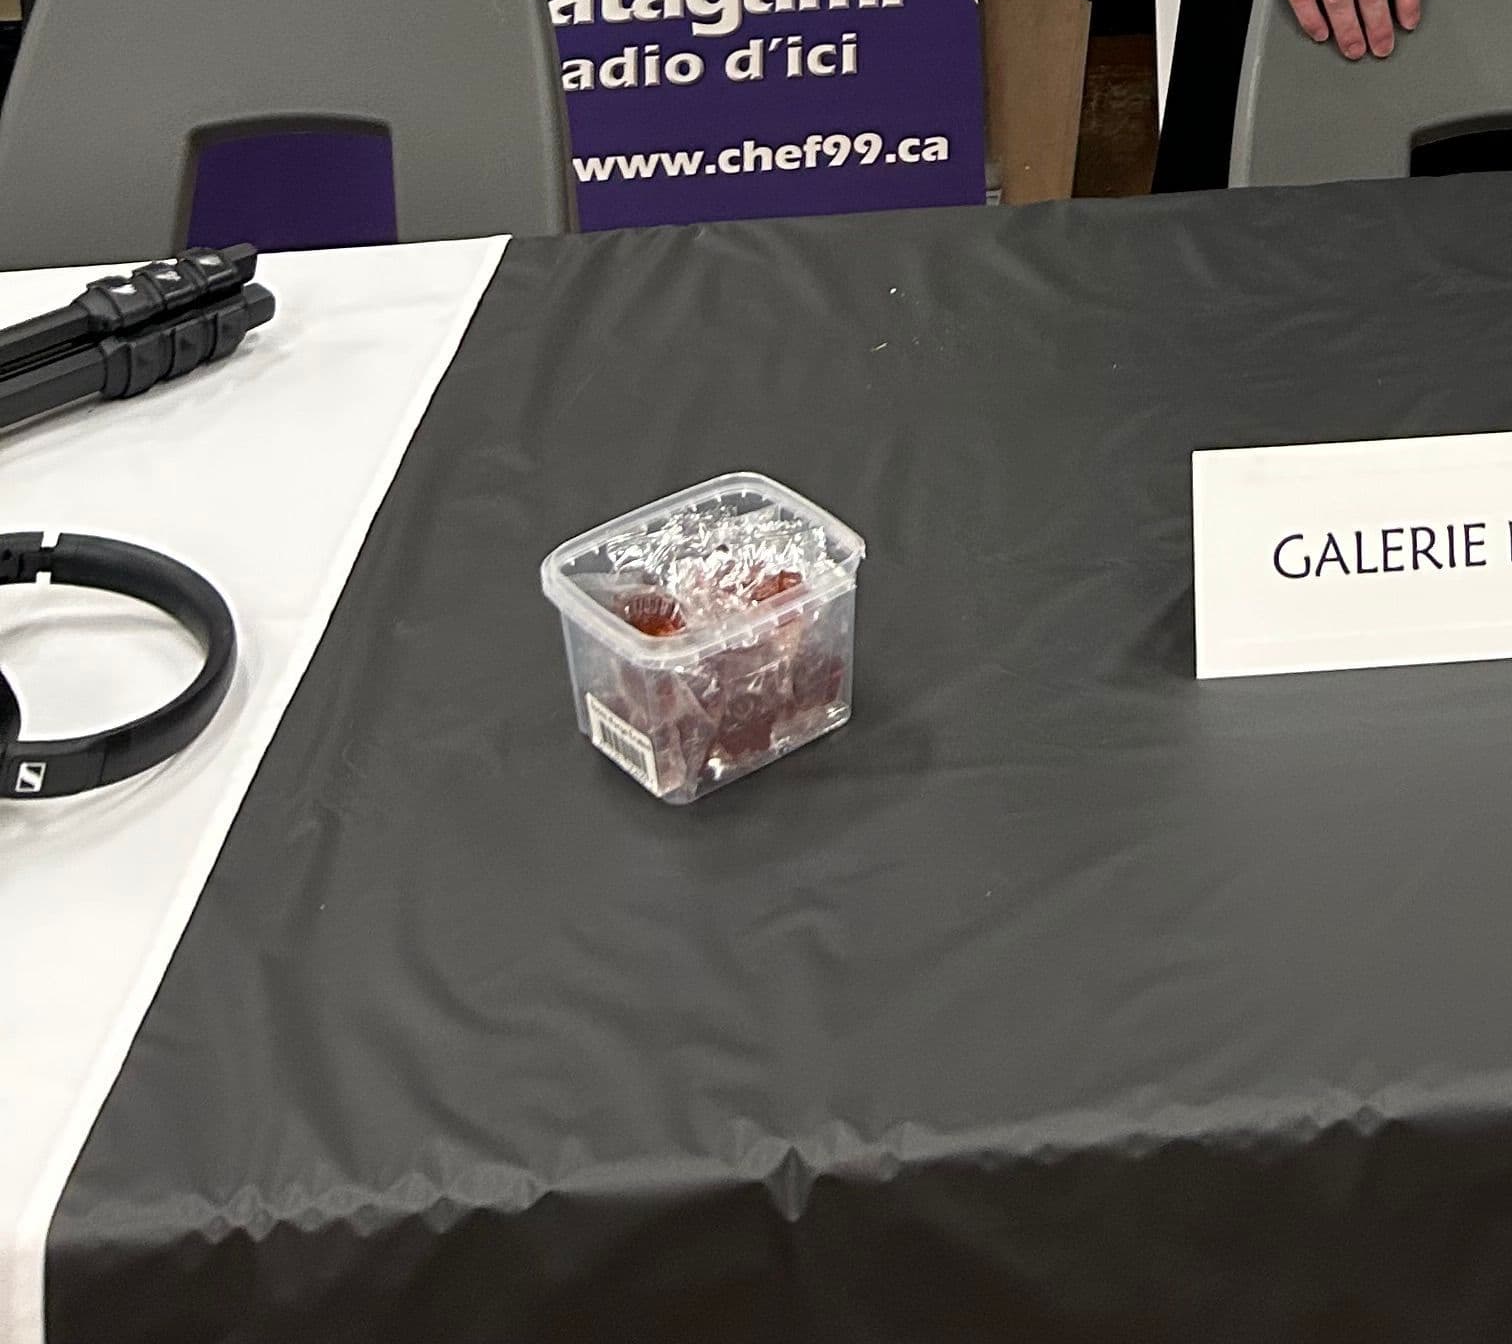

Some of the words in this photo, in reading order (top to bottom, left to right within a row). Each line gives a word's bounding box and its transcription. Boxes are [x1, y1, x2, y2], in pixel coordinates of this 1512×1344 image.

[561, 43, 705, 92] adio
[724, 32, 858, 82] d'ici
[572, 132, 950, 183] www.chef99.ca
[1273, 522, 1487, 579] GALERIE
